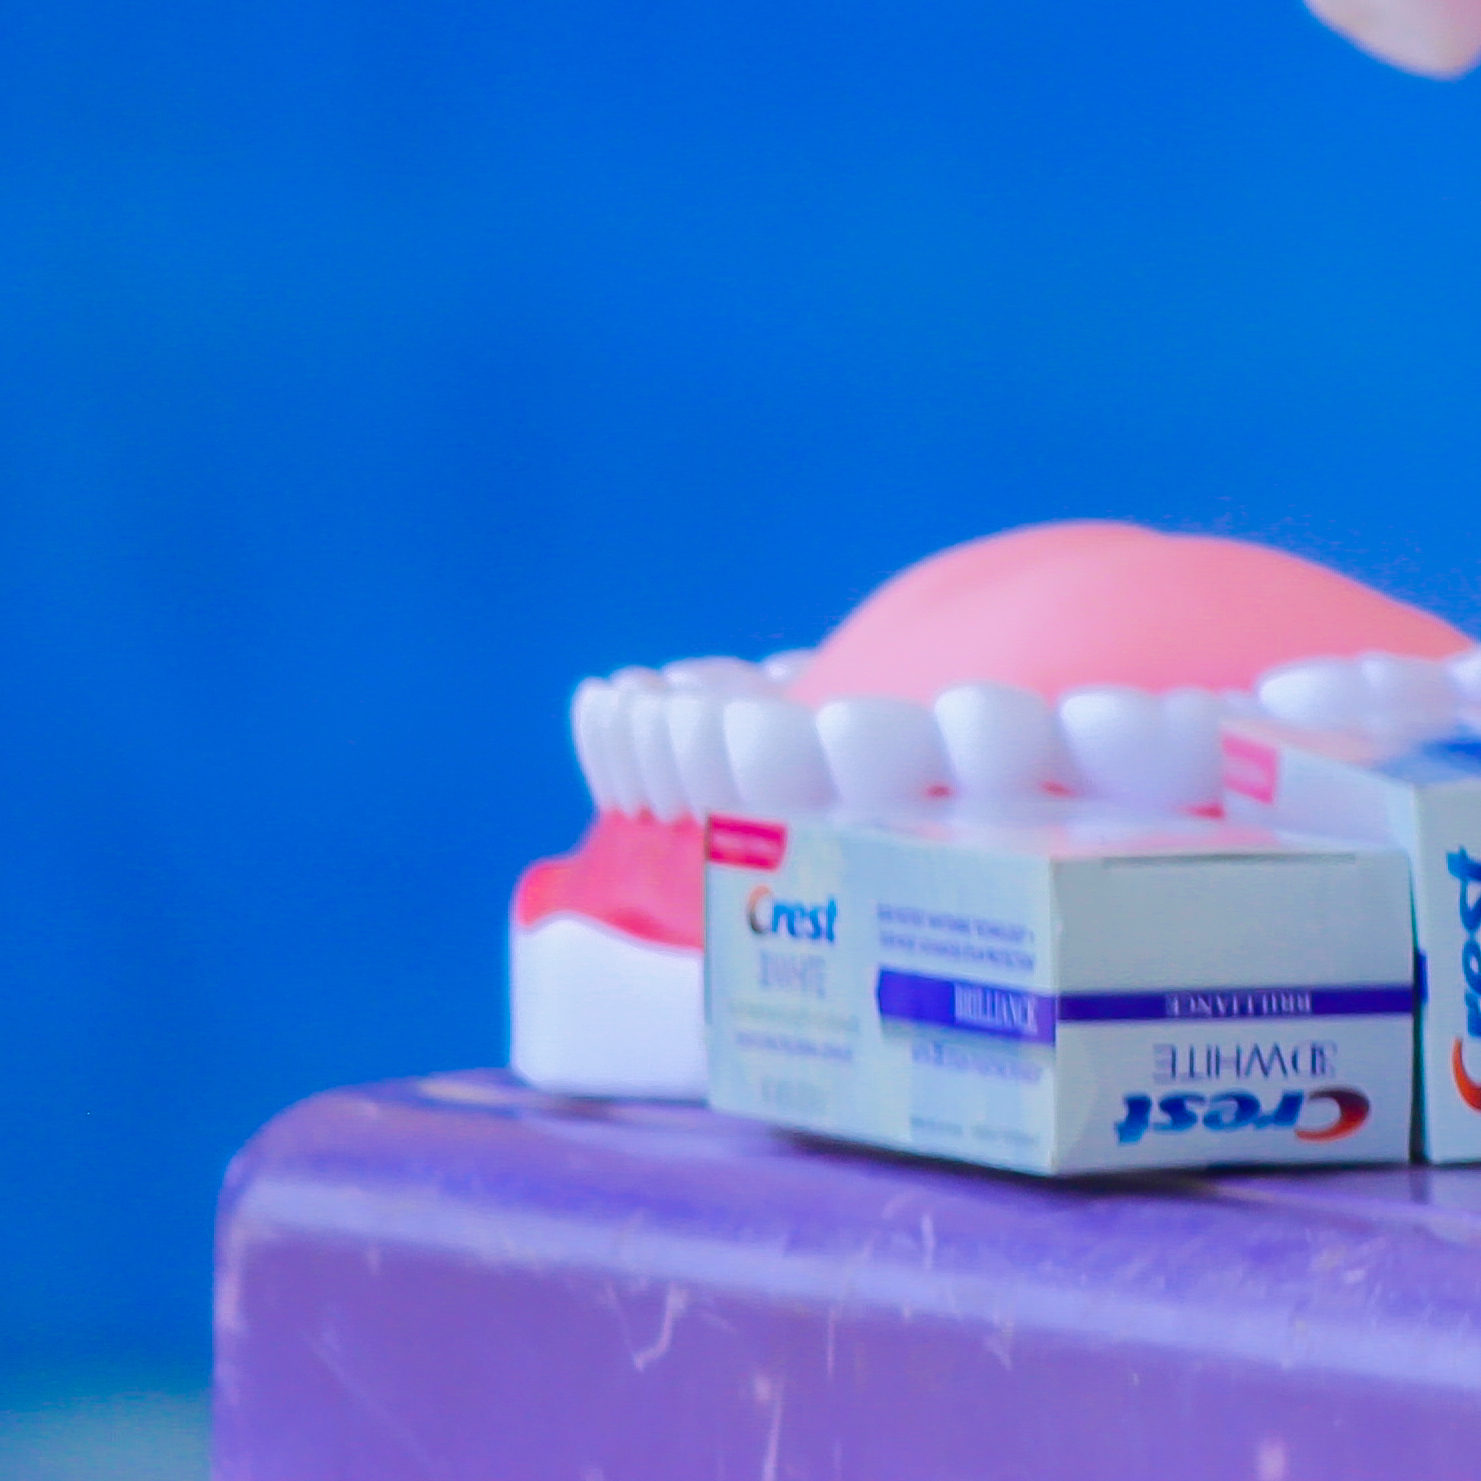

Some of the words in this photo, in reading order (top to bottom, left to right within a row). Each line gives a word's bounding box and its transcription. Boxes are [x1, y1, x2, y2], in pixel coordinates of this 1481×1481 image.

[746, 884, 839, 943] Crest
[1164, 992, 1313, 1018] BRILLIANCE
[1115, 1086, 1371, 1146] Crest
